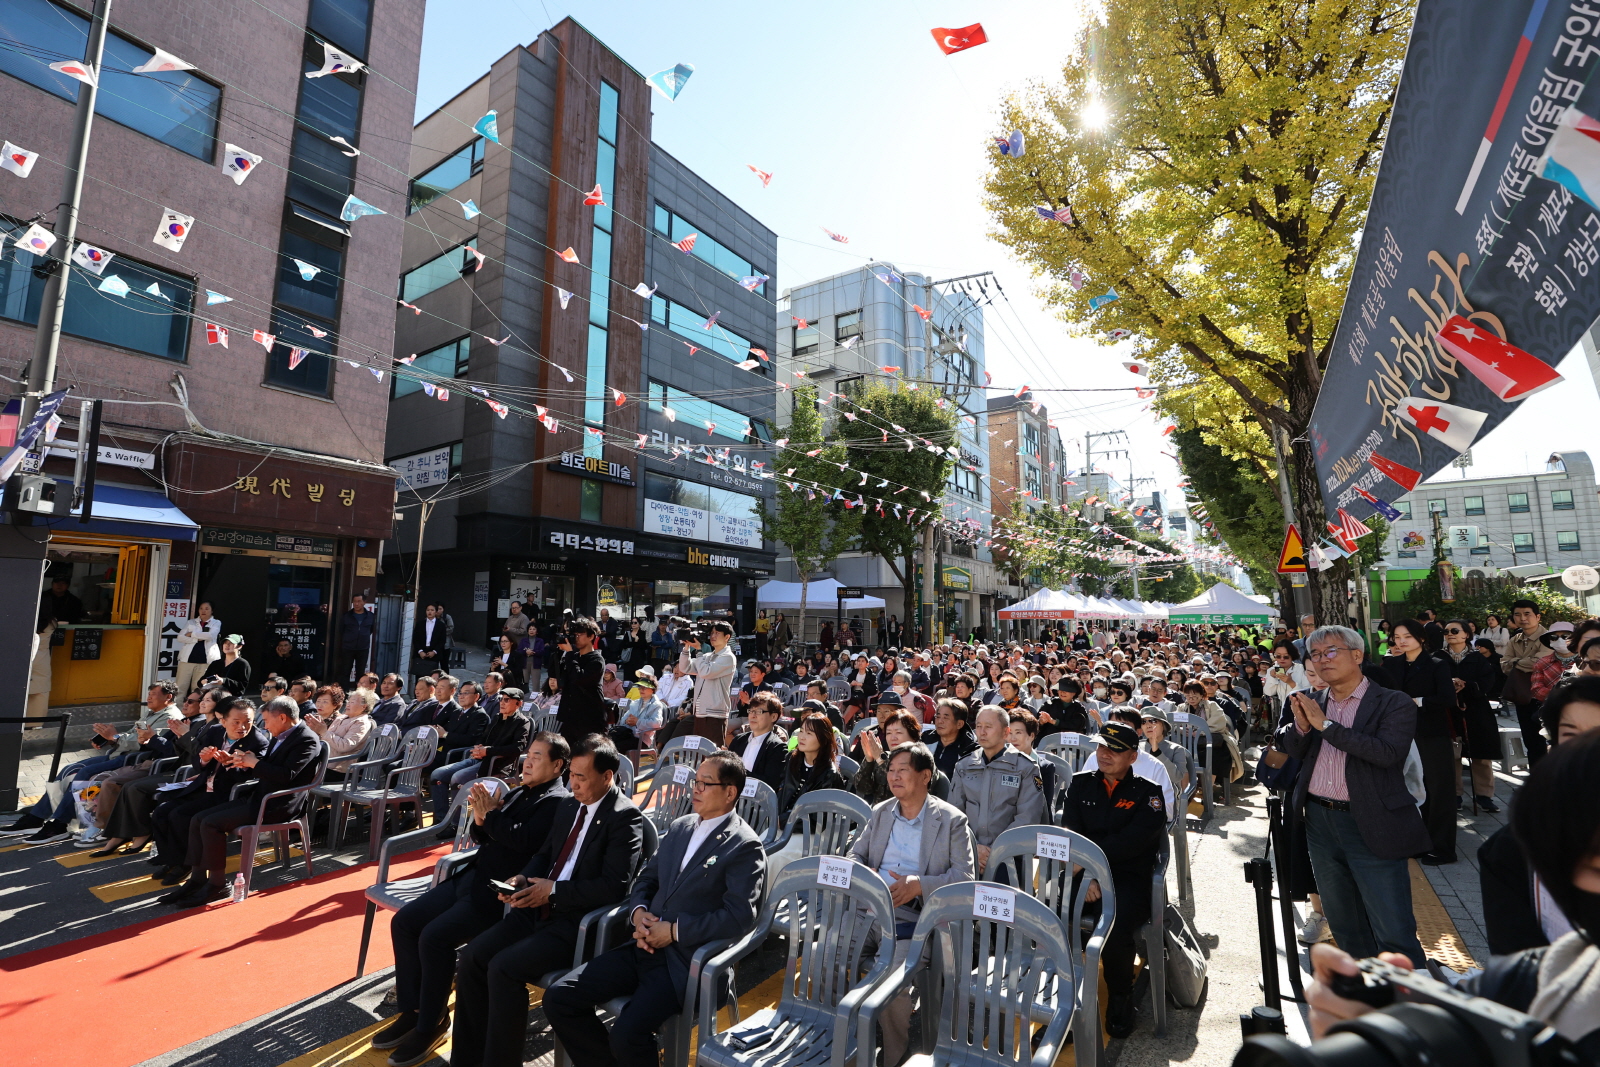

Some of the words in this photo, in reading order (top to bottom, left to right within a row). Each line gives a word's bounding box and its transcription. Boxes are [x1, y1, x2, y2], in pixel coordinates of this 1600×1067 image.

[1506, 242, 1539, 282] 주관
[1534, 275, 1568, 317] 후원
[114, 452, 145, 464] Waffle
[207, 530, 272, 546] 우리영어교습소
[550, 531, 635, 556] 리더스한의원
[688, 547, 709, 565] bhc
[709, 554, 739, 569] CHICKEN
[526, 561, 548, 570] YEON
[550, 563, 566, 572] HEE
[1201, 614, 1235, 624] 푸드존
[982, 894, 1009, 905] 강남구의원
[979, 903, 1011, 918] 이동호
